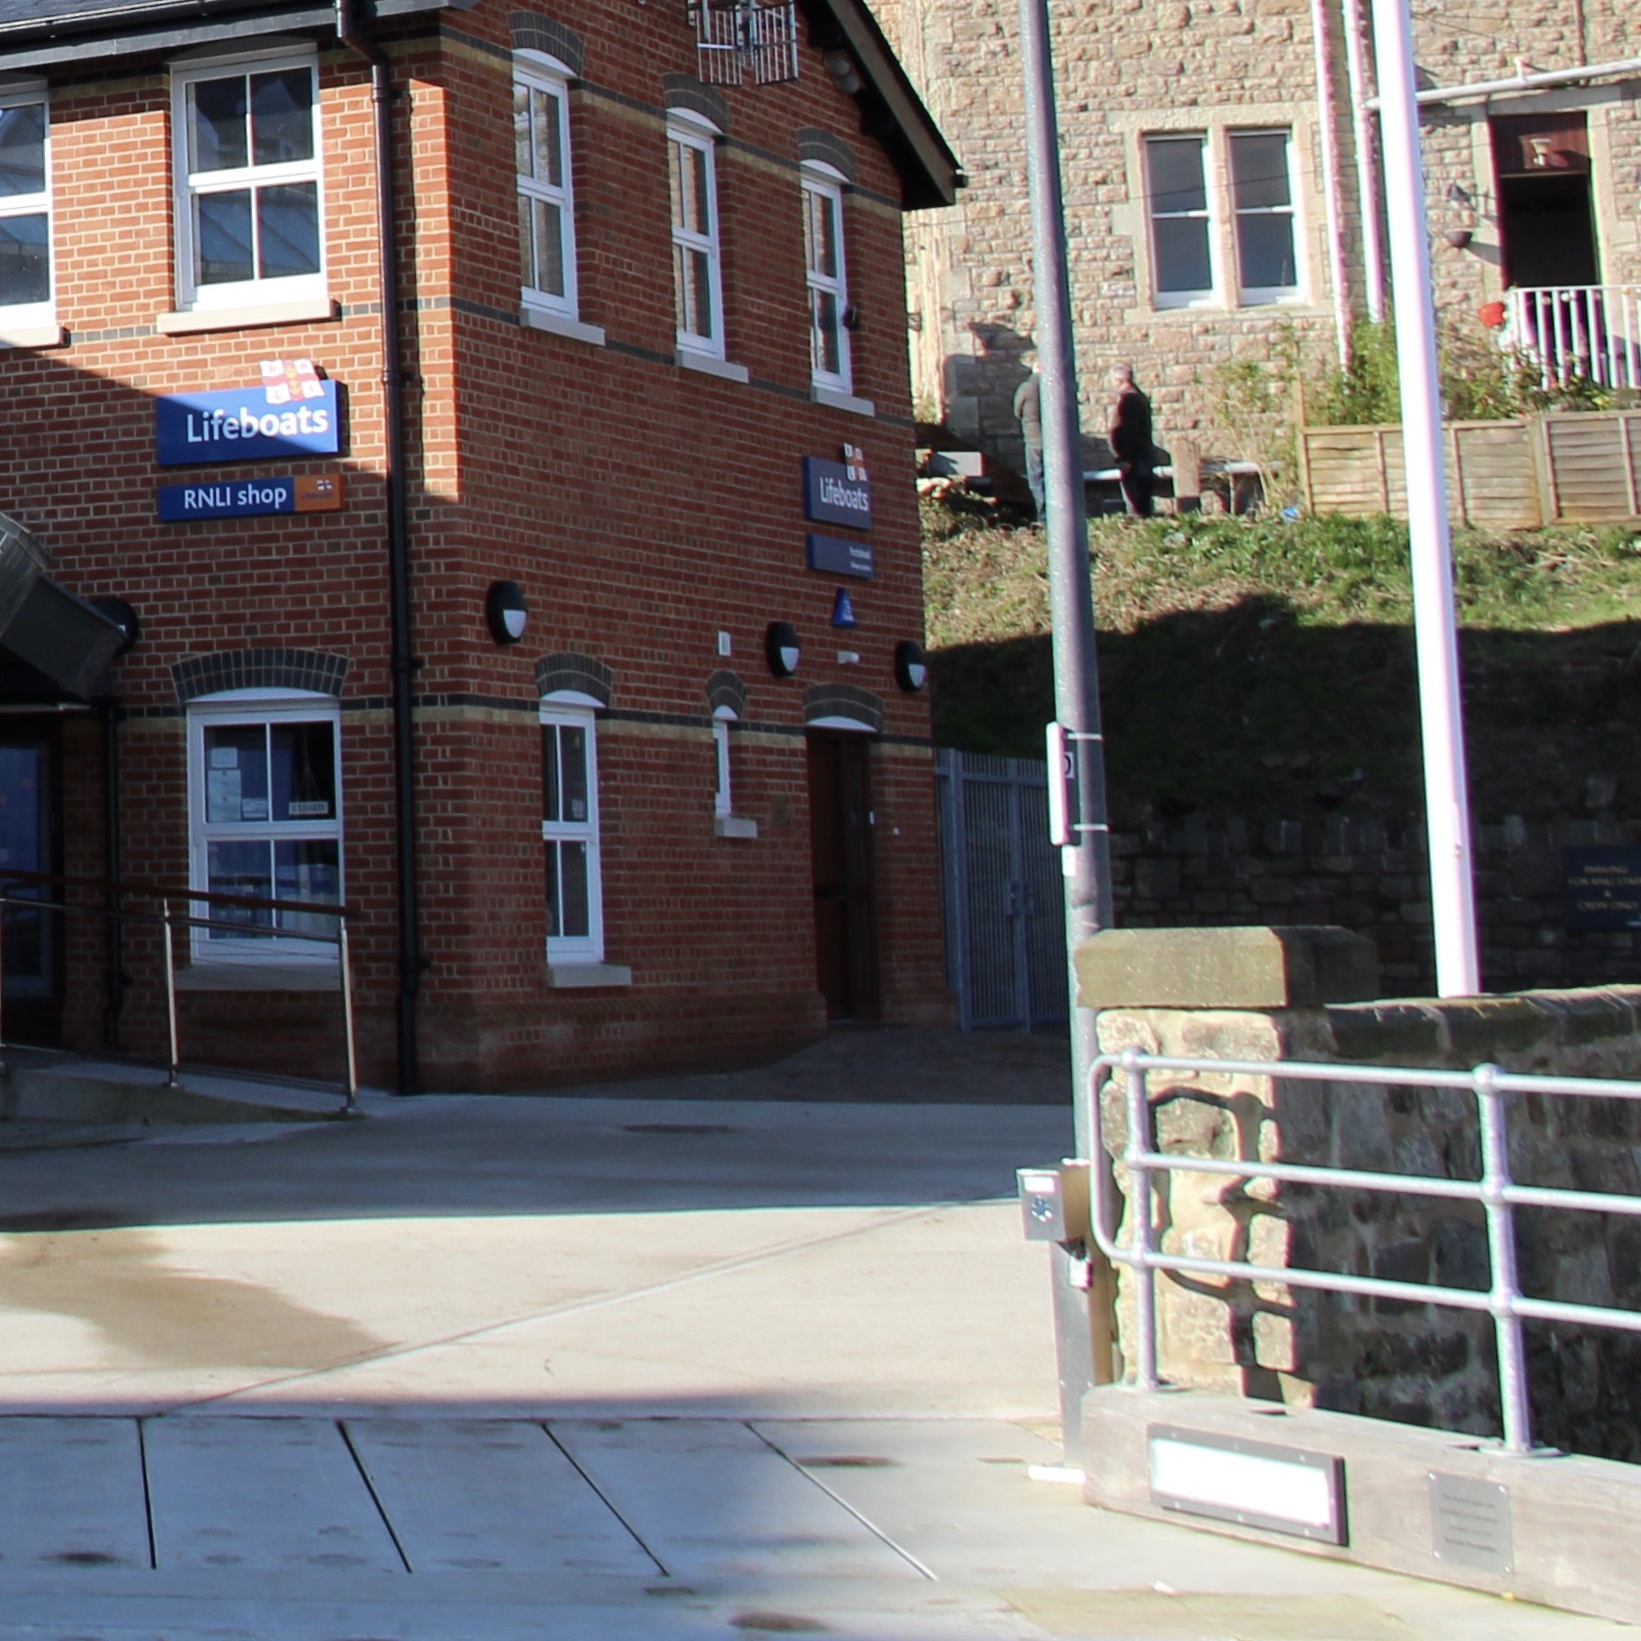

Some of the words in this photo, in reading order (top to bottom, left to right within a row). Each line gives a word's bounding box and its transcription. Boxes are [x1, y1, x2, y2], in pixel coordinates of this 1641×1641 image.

[187, 406, 329, 443] Lifeboats
[184, 487, 232, 509] RNLI
[237, 484, 287, 509] shop
[819, 476, 869, 511] Lifeboats
